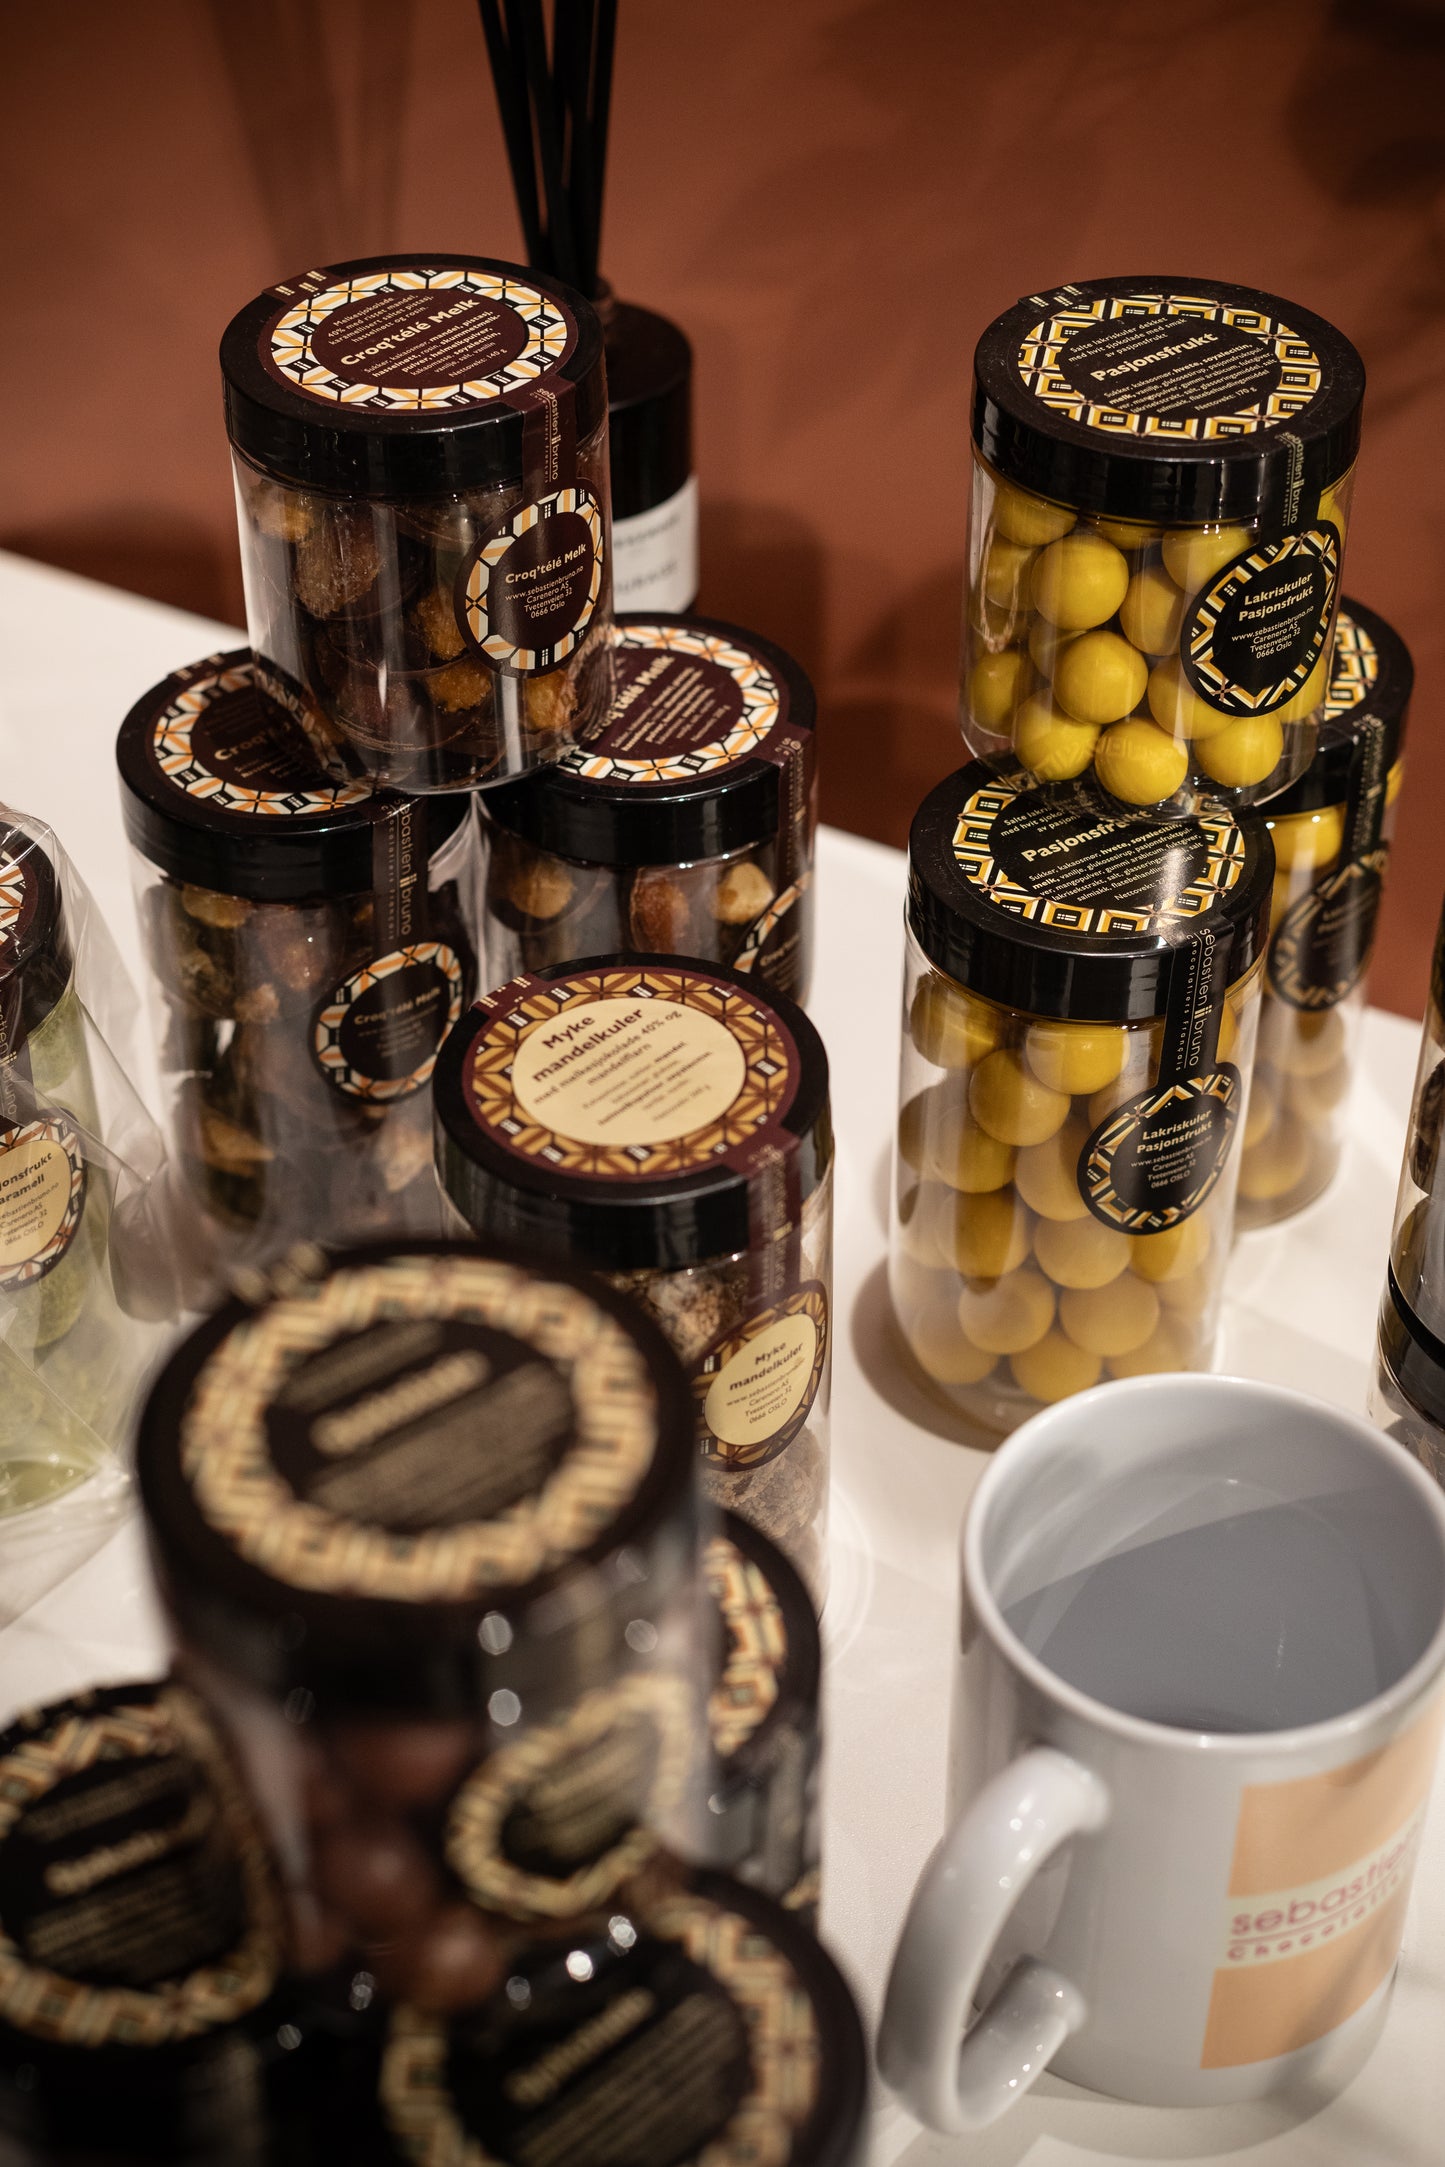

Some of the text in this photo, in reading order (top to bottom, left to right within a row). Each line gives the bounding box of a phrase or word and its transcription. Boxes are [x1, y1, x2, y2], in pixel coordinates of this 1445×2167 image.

[333, 298, 394, 326] Melkesjokolade
[346, 320, 364, 329] med
[429, 297, 480, 324] Melk
[1068, 318, 1188, 363] med hvit sjokolade med smak
[1069, 317, 1168, 353] Salte lakriskuler dekket
[1116, 333, 1169, 355] pasjonsfrukt
[401, 357, 432, 373] pulver,
[1090, 331, 1219, 382] Pasjonsfrukt
[1109, 393, 1136, 404] melk,
[1236, 388, 1250, 397] 170
[552, 444, 560, 480] bruno
[1290, 488, 1302, 524] bruno
[564, 544, 586, 563] Melk
[526, 581, 570, 604] Carenero AS
[1239, 585, 1313, 622] Pasjonsfrukt
[1244, 573, 1312, 606] Lakriskuler
[530, 607, 548, 618] 0666
[1250, 627, 1301, 653] Tvetenveien 32
[1253, 621, 1298, 644] Carenero AS
[1256, 640, 1293, 659] 0666 Oslo
[1000, 826, 1020, 837] med
[1020, 819, 1039, 830] hvit
[1003, 815, 1027, 826] Salte
[1028, 868, 1059, 882] Sukker,
[1100, 839, 1131, 856] hvete,
[1130, 822, 1183, 845] soyalecitin,
[1032, 827, 1193, 890] melk, vanilje, glukosesirup, pasjonsfruktpul-
[1039, 833, 1202, 897] ver, mangopulver, gummi arabicum, fuktgiver,
[1052, 879, 1106, 902] lakrisekstrakt,
[1106, 872, 1124, 882] salt,
[1188, 842, 1203, 850] salt
[1077, 887, 1113, 902] salmiakk,
[1114, 881, 1157, 901] Nettovekt:
[401, 886, 413, 936] bruno
[1189, 928, 1216, 1066] sebastien bruno
[532, 1009, 644, 1082] mandelkuler
[542, 1016, 595, 1049] Myke
[1136, 1120, 1212, 1154] Pasjonsfrukt
[1142, 1110, 1212, 1140] Lakriskuler
[0, 1173, 45, 1205] aramell
[729, 1342, 803, 1391] mandelkuler
[755, 1342, 787, 1365] Myke
